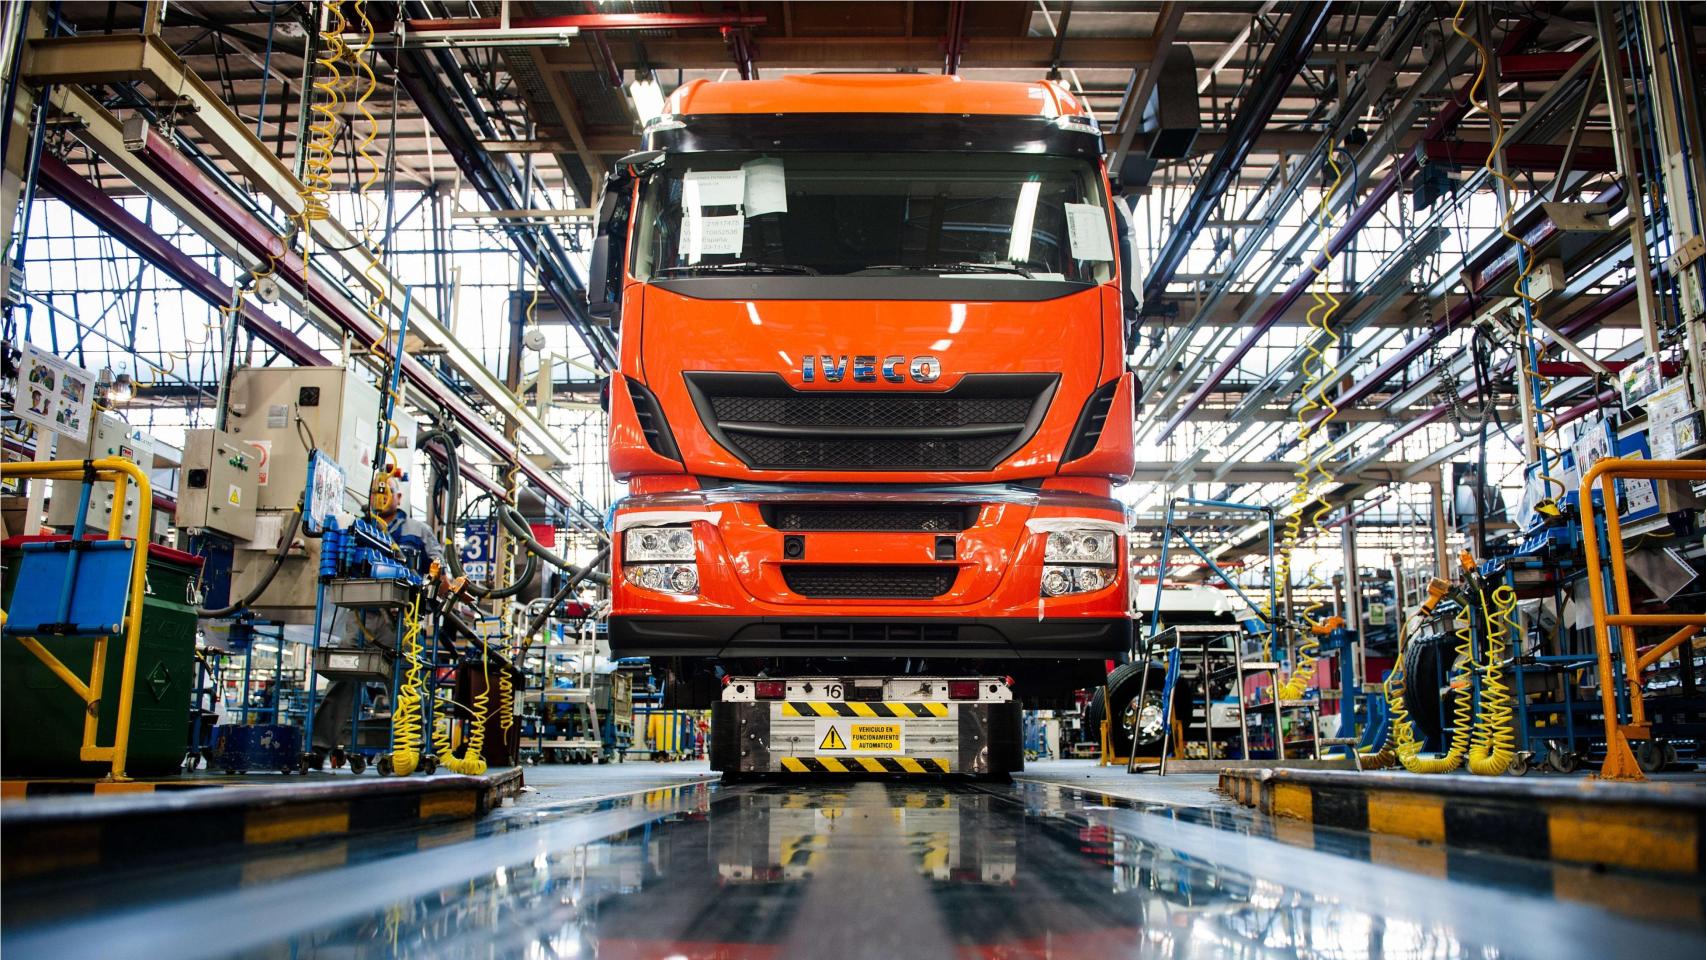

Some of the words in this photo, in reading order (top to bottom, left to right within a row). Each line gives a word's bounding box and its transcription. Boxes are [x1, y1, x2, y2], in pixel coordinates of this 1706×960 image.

[802, 355, 941, 383] IVECO
[466, 534, 496, 560] 31
[823, 684, 843, 699] 16
